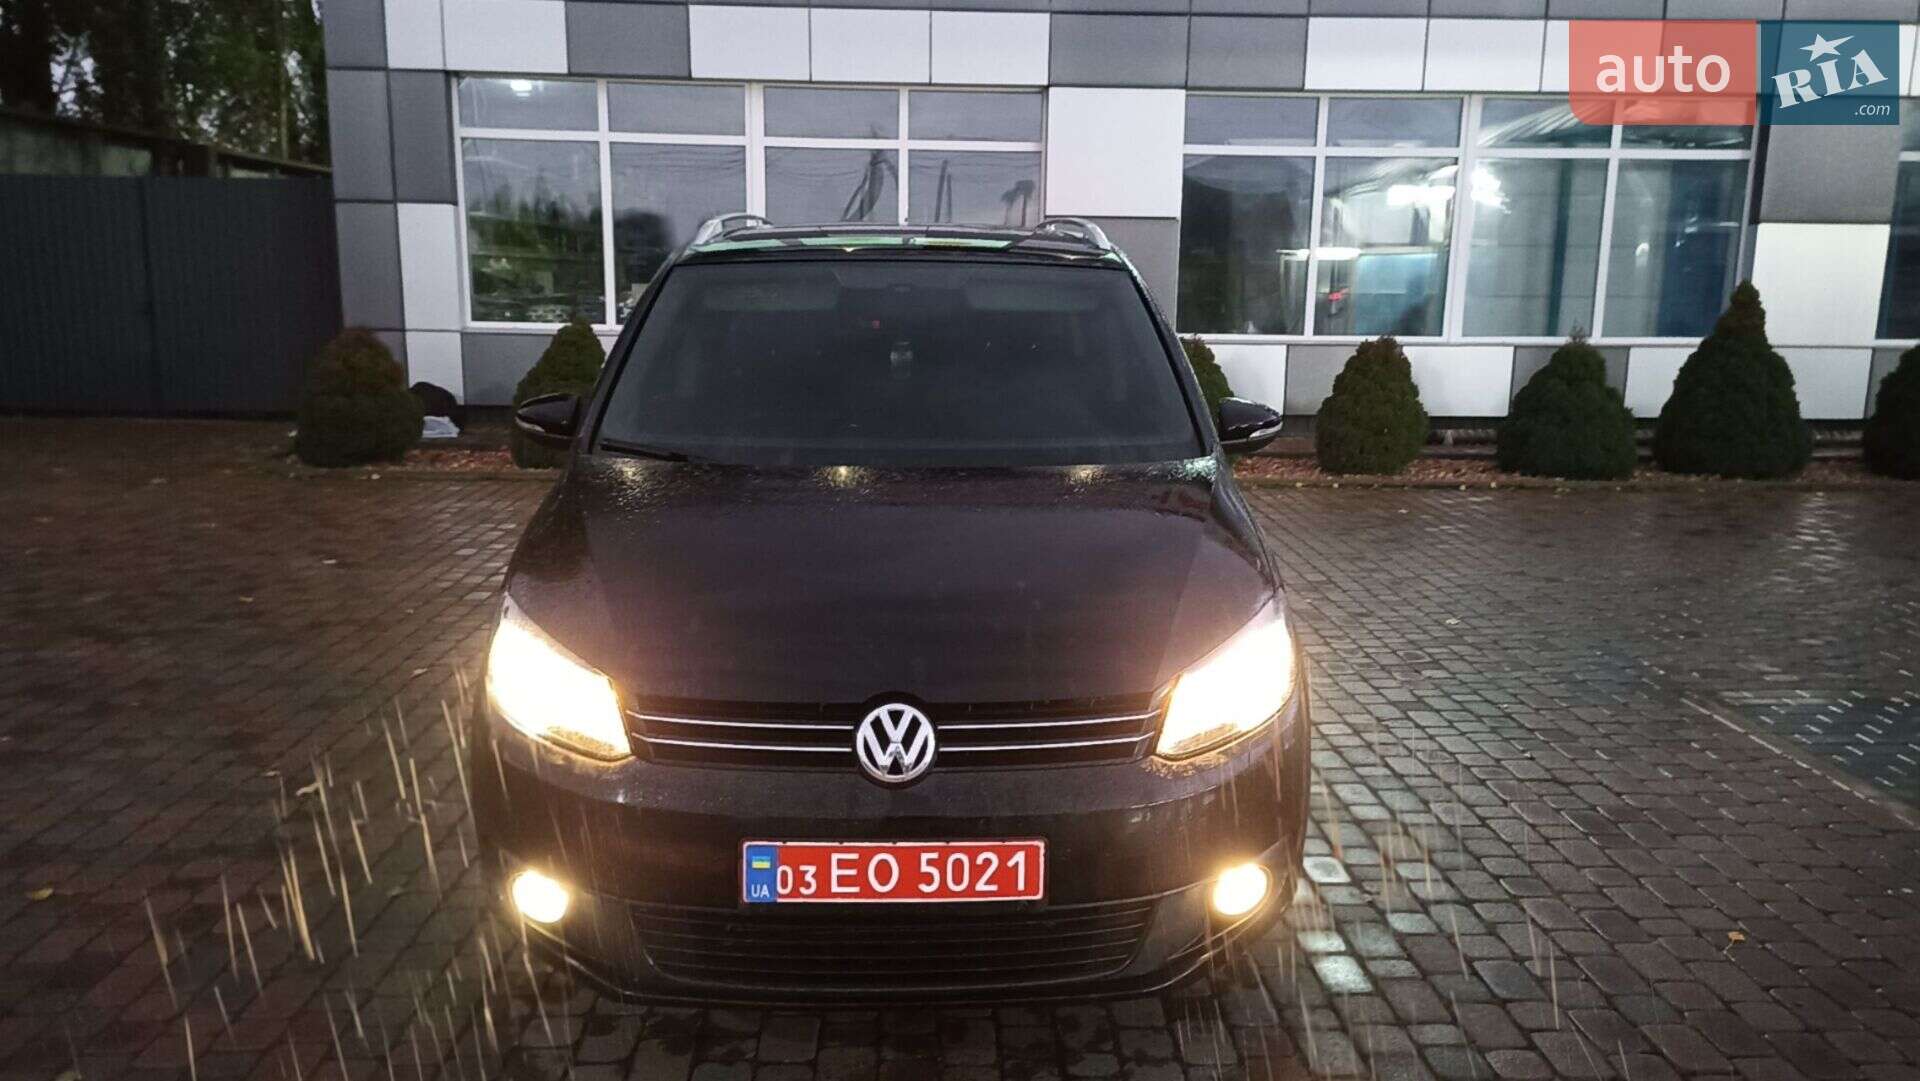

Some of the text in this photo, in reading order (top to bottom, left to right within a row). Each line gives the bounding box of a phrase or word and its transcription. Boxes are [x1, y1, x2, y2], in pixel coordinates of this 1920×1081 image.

[776, 850, 1026, 895] 03 EO 5021
[751, 884, 770, 898] UA
